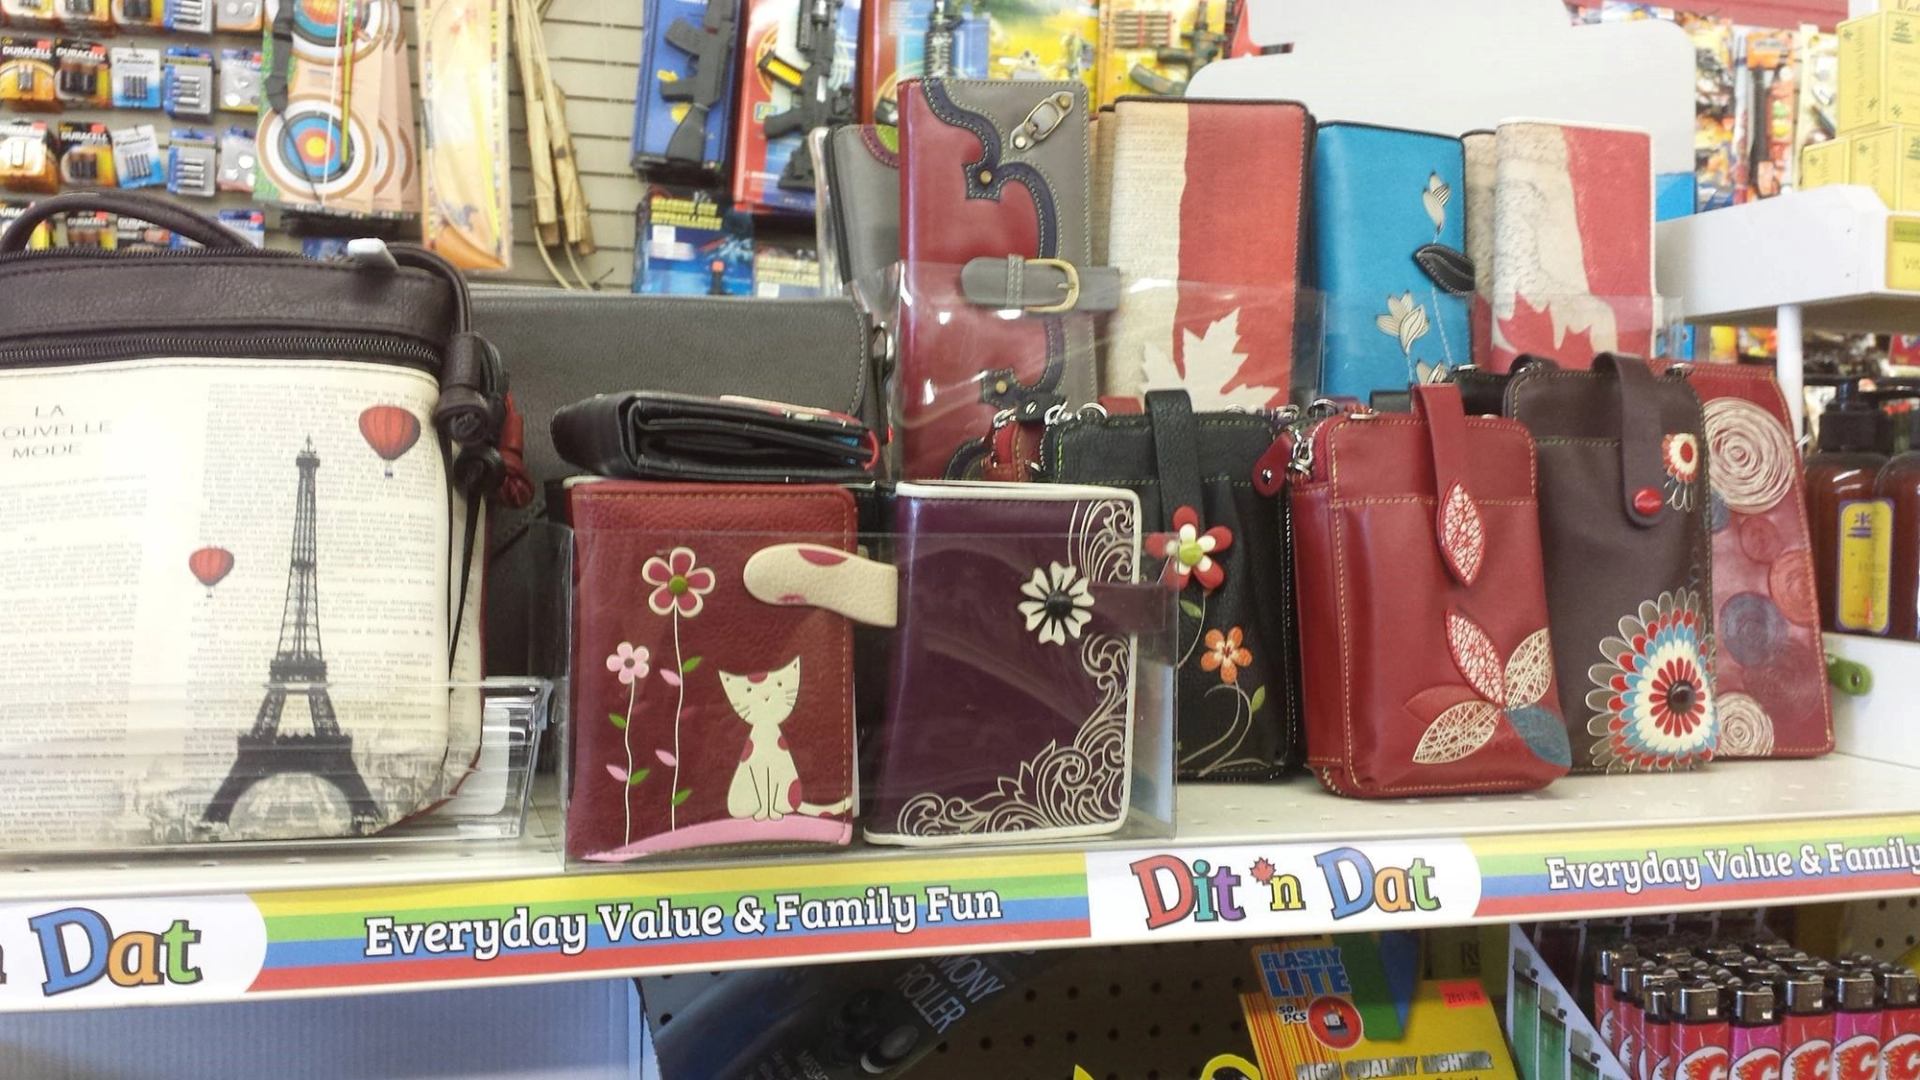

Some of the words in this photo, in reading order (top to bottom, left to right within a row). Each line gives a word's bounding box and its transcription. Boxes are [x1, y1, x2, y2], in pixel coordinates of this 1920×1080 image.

[2, 46, 52, 59] DURACELL
[56, 47, 106, 60] DURACELL
[60, 131, 108, 142] DURACELL
[67, 217, 107, 227] DURACELL
[35, 403, 65, 419] LA
[0, 420, 112, 444] OUVELLE
[12, 443, 82, 459] MODE
[1546, 850, 1702, 894] Everyday
[1704, 845, 1794, 880] Value
[1799, 843, 1824, 876] &
[1825, 836, 1920, 876] Family
[1129, 853, 1246, 930] Dit
[1313, 846, 1442, 920] Dat
[364, 905, 588, 961] Everyday
[596, 898, 724, 943] Value
[732, 896, 766, 935] &
[774, 886, 917, 934] Family
[924, 885, 1003, 923] Fun
[28, 906, 204, 997] Dat
[1259, 947, 1342, 970] FLASHY
[930, 955, 1006, 1004] MONY
[1264, 966, 1352, 999] LITE
[893, 962, 967, 1034] ROLLER
[1284, 1012, 1307, 1023] PCS
[1297, 1063, 1342, 1080] HIGH
[1345, 1056, 1418, 1080] QUALITY
